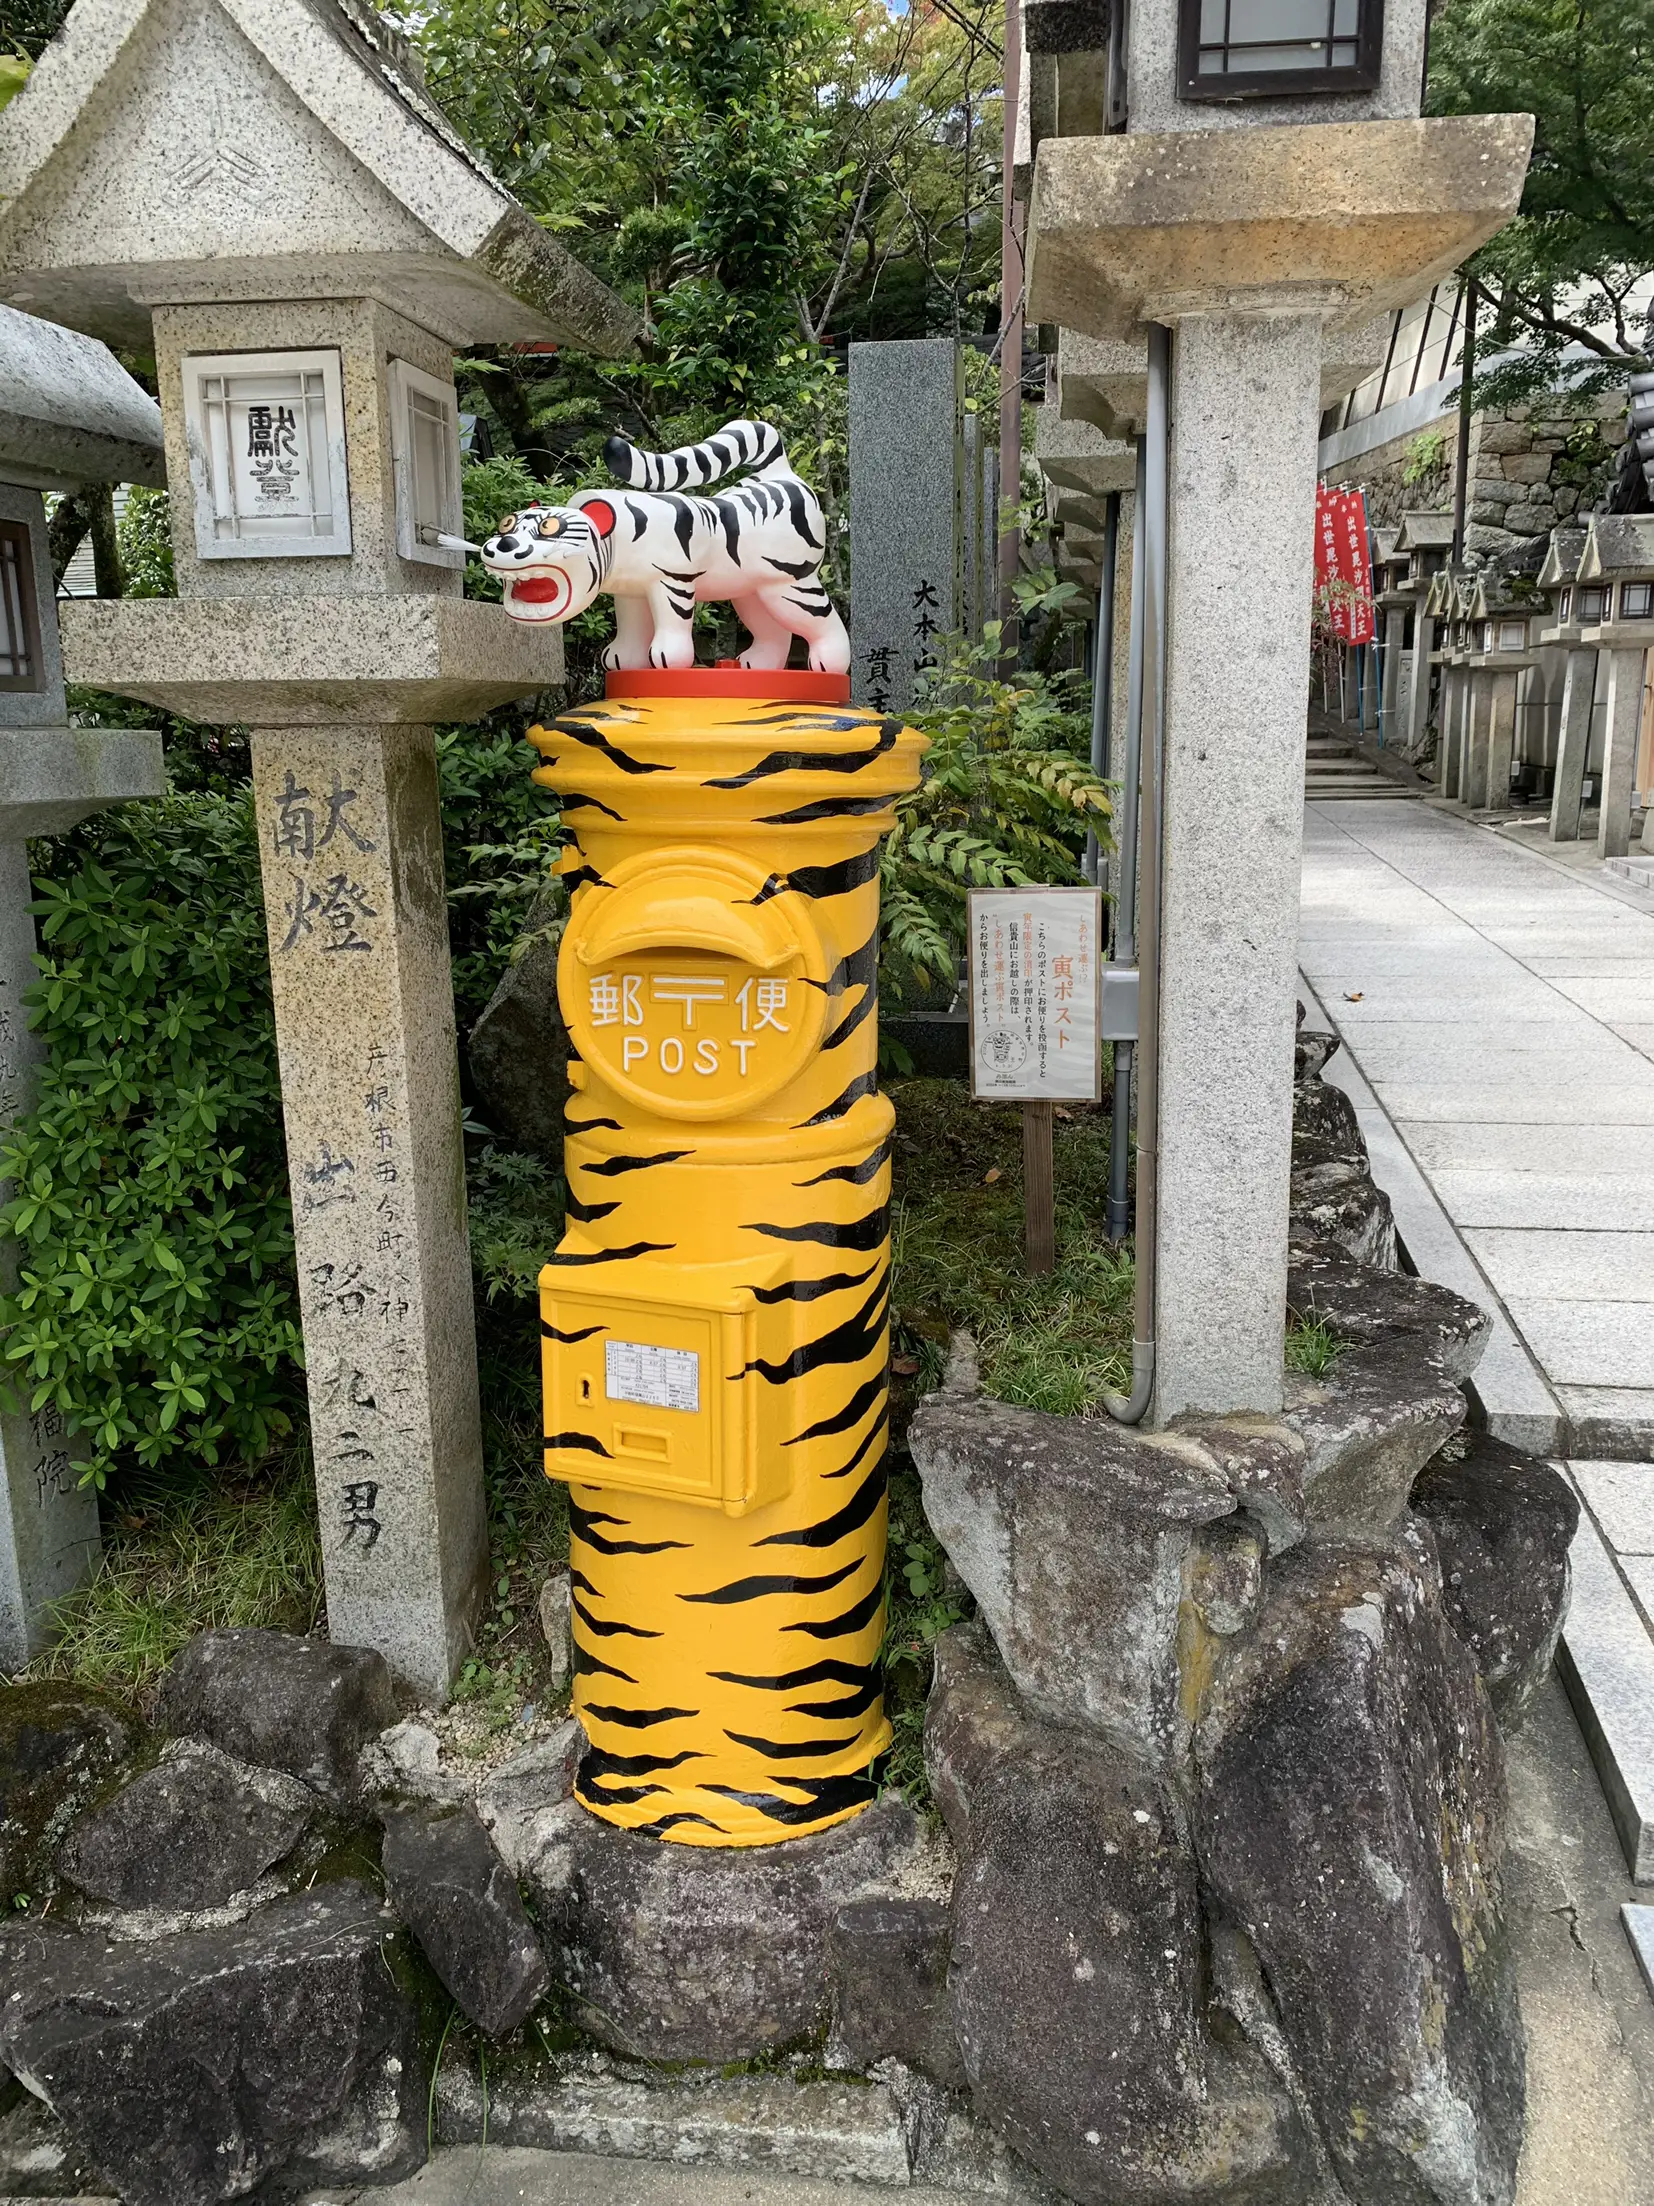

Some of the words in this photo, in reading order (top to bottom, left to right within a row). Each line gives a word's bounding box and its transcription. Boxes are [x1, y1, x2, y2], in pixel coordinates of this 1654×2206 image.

[1322, 512, 1345, 629] 出世毘沙天王
[979, 913, 991, 1028] からお便りを出しましょう。
[1009, 921, 1021, 1019] 信貴山にお越しの際は、
[1037, 922, 1048, 1078] こちらのポストにお便りを投函すると
[1052, 954, 1074, 1049] 寅ポスト
[622, 1036, 757, 1077] POST
